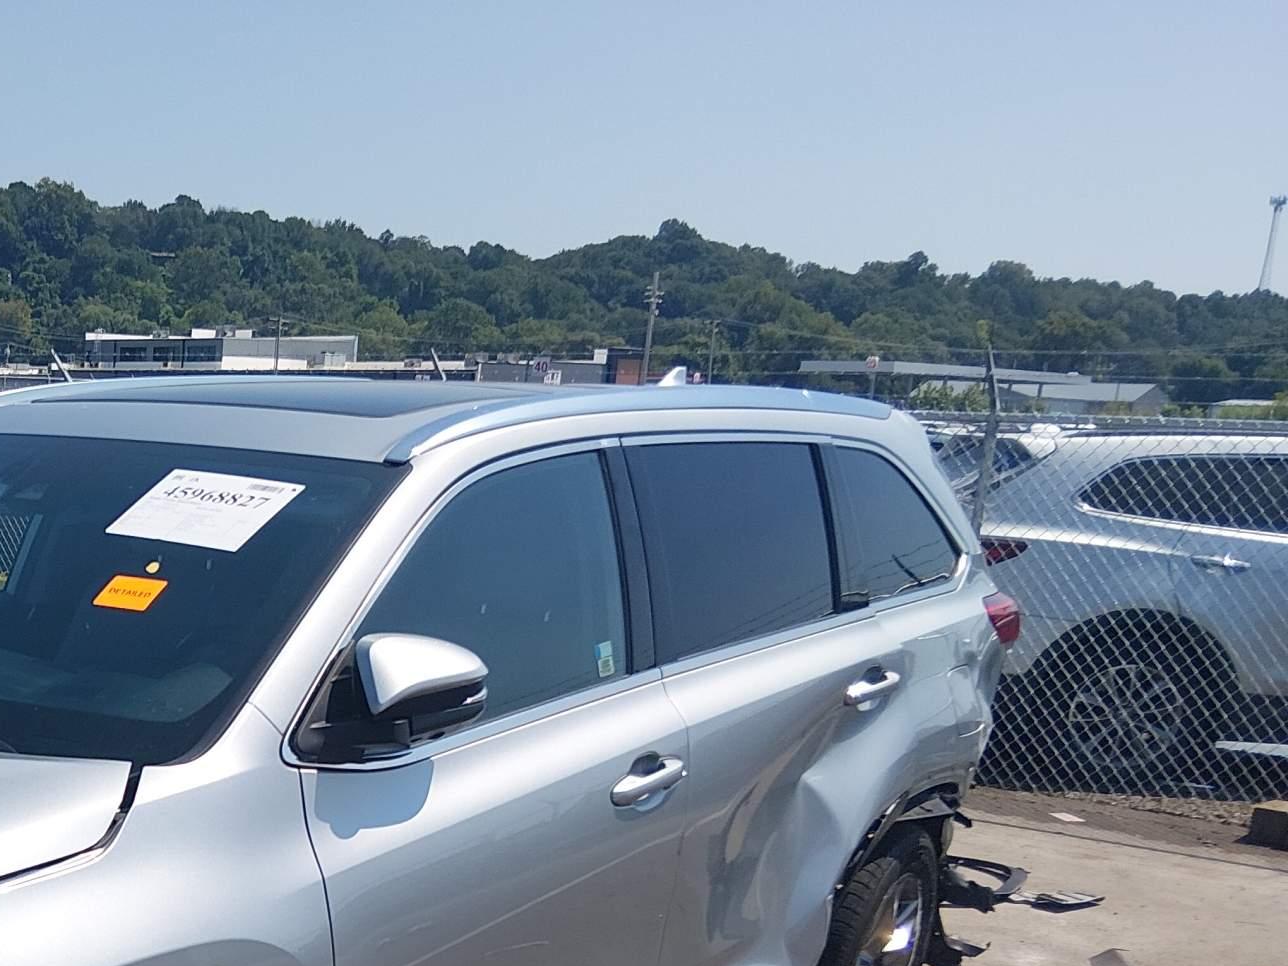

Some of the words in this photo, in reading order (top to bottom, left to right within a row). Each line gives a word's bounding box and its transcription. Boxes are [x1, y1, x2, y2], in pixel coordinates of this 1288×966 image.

[535, 361, 548, 373] 40
[164, 486, 271, 509] 45968827
[109, 587, 152, 598] DETAILED
